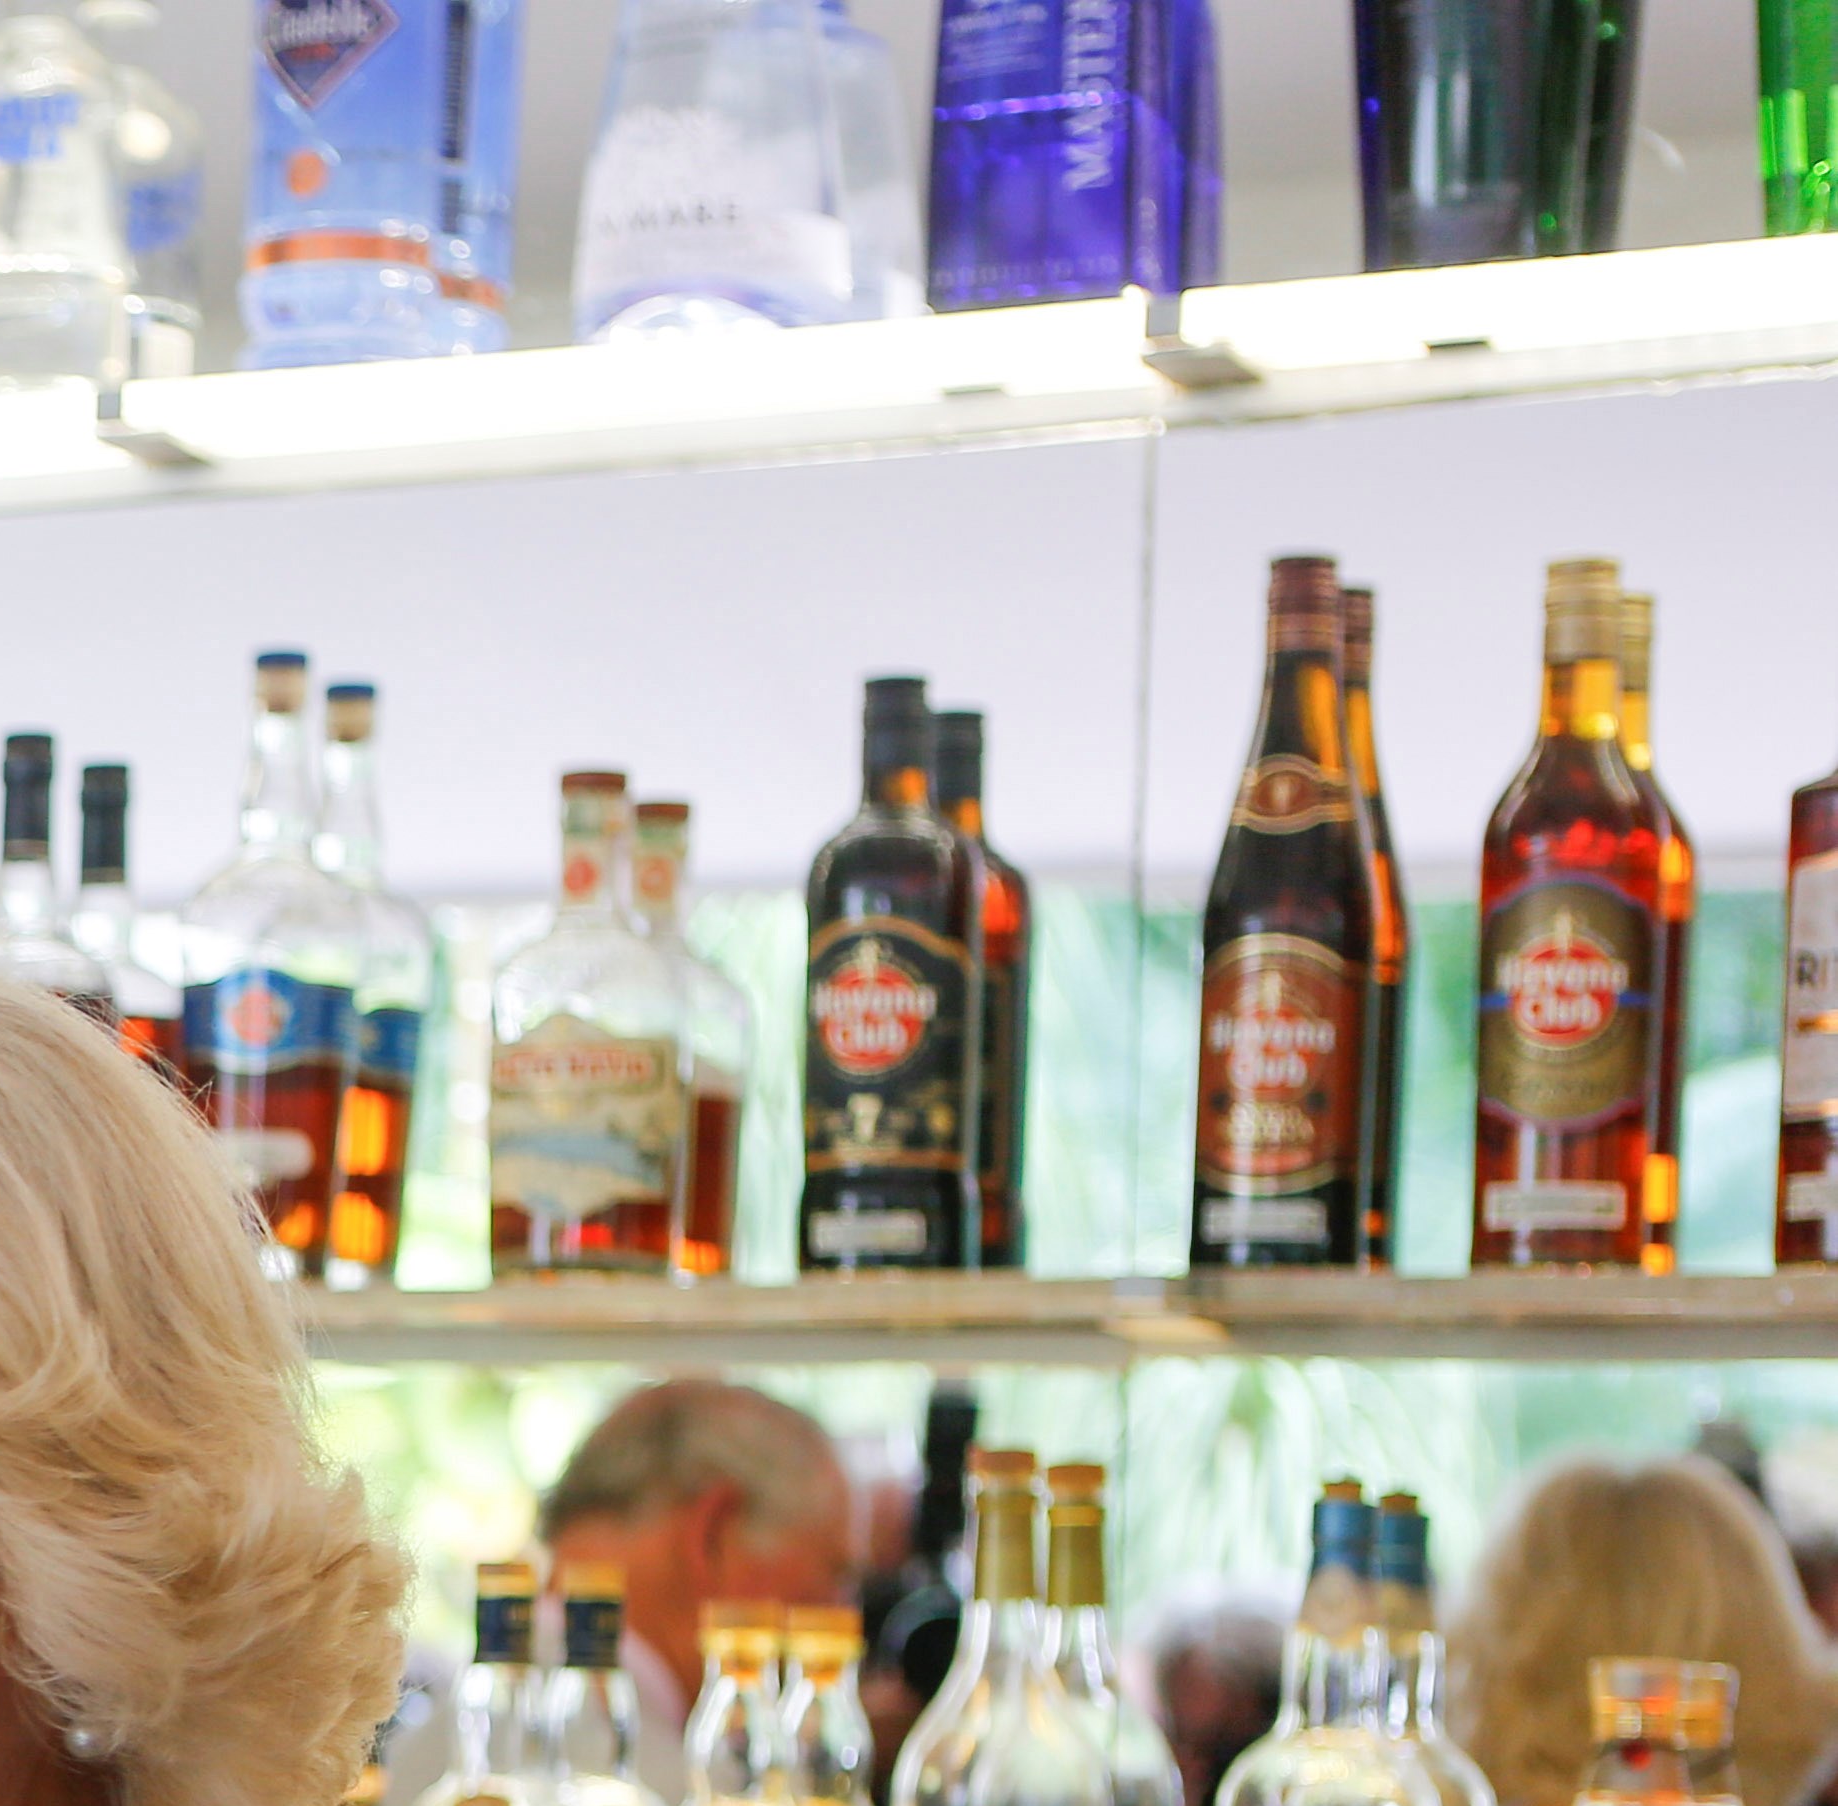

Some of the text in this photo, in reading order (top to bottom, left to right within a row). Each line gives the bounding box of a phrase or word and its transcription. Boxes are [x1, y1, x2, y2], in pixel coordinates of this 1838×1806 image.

[1495, 954, 1630, 996] Havana
[813, 981, 937, 1021] Havana
[1520, 990, 1603, 1030] Club
[830, 1013, 909, 1053] Club
[1209, 1013, 1337, 1055] Havana
[1229, 1048, 1308, 1089] Club
